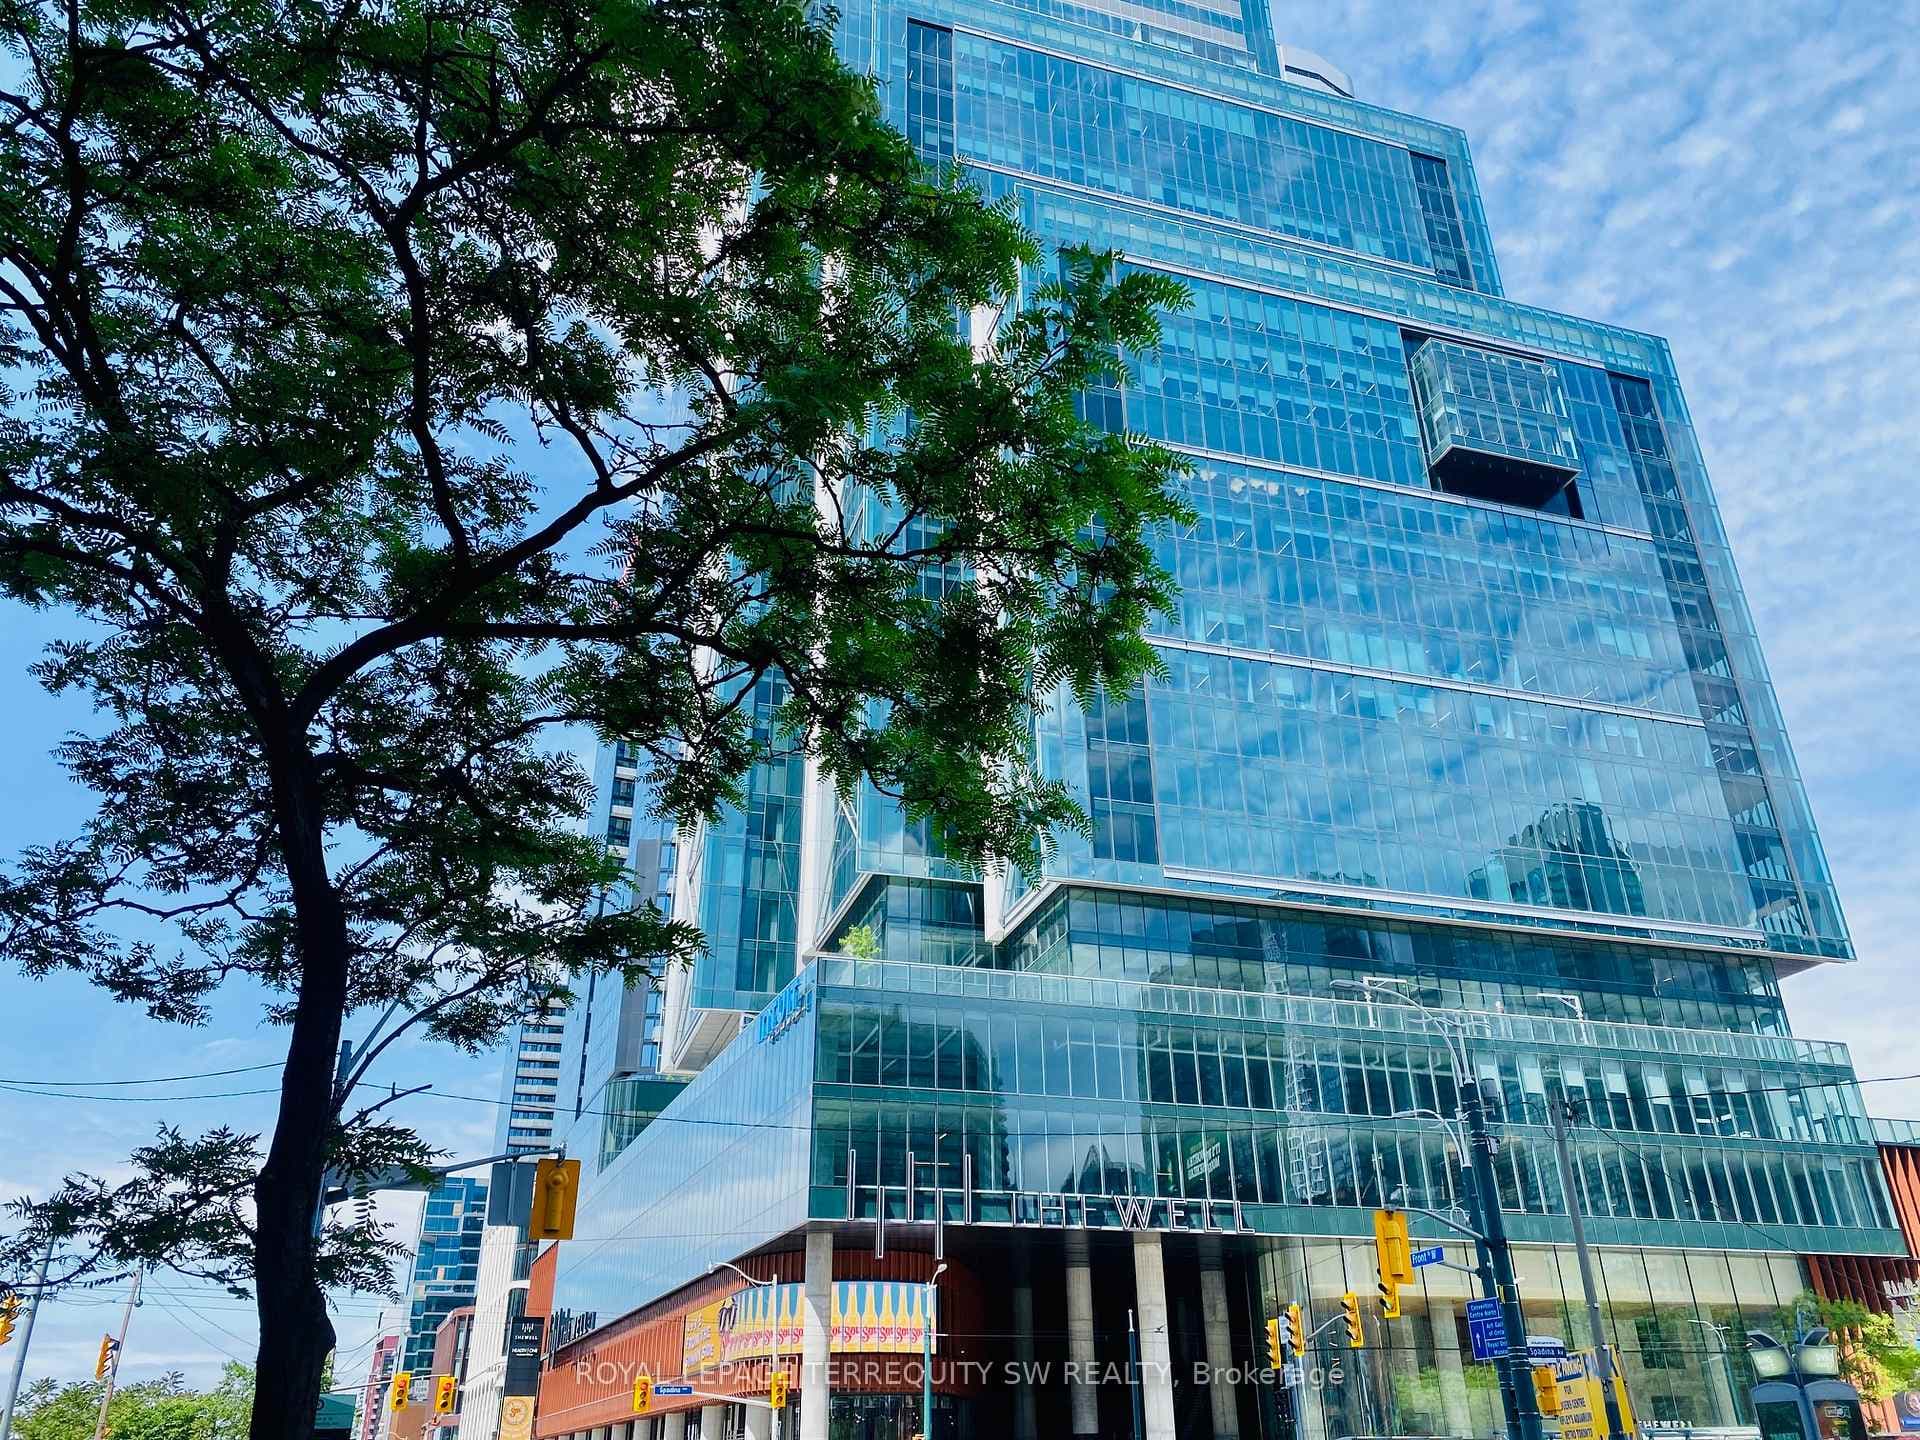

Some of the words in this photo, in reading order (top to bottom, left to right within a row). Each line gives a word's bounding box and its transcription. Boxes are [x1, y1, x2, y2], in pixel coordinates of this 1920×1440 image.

[1003, 1191, 1101, 1229] THE
[1114, 1195, 1256, 1234] WELL
[1412, 1252, 1427, 1265] Front
[1529, 1347, 1555, 1357] Spadina
